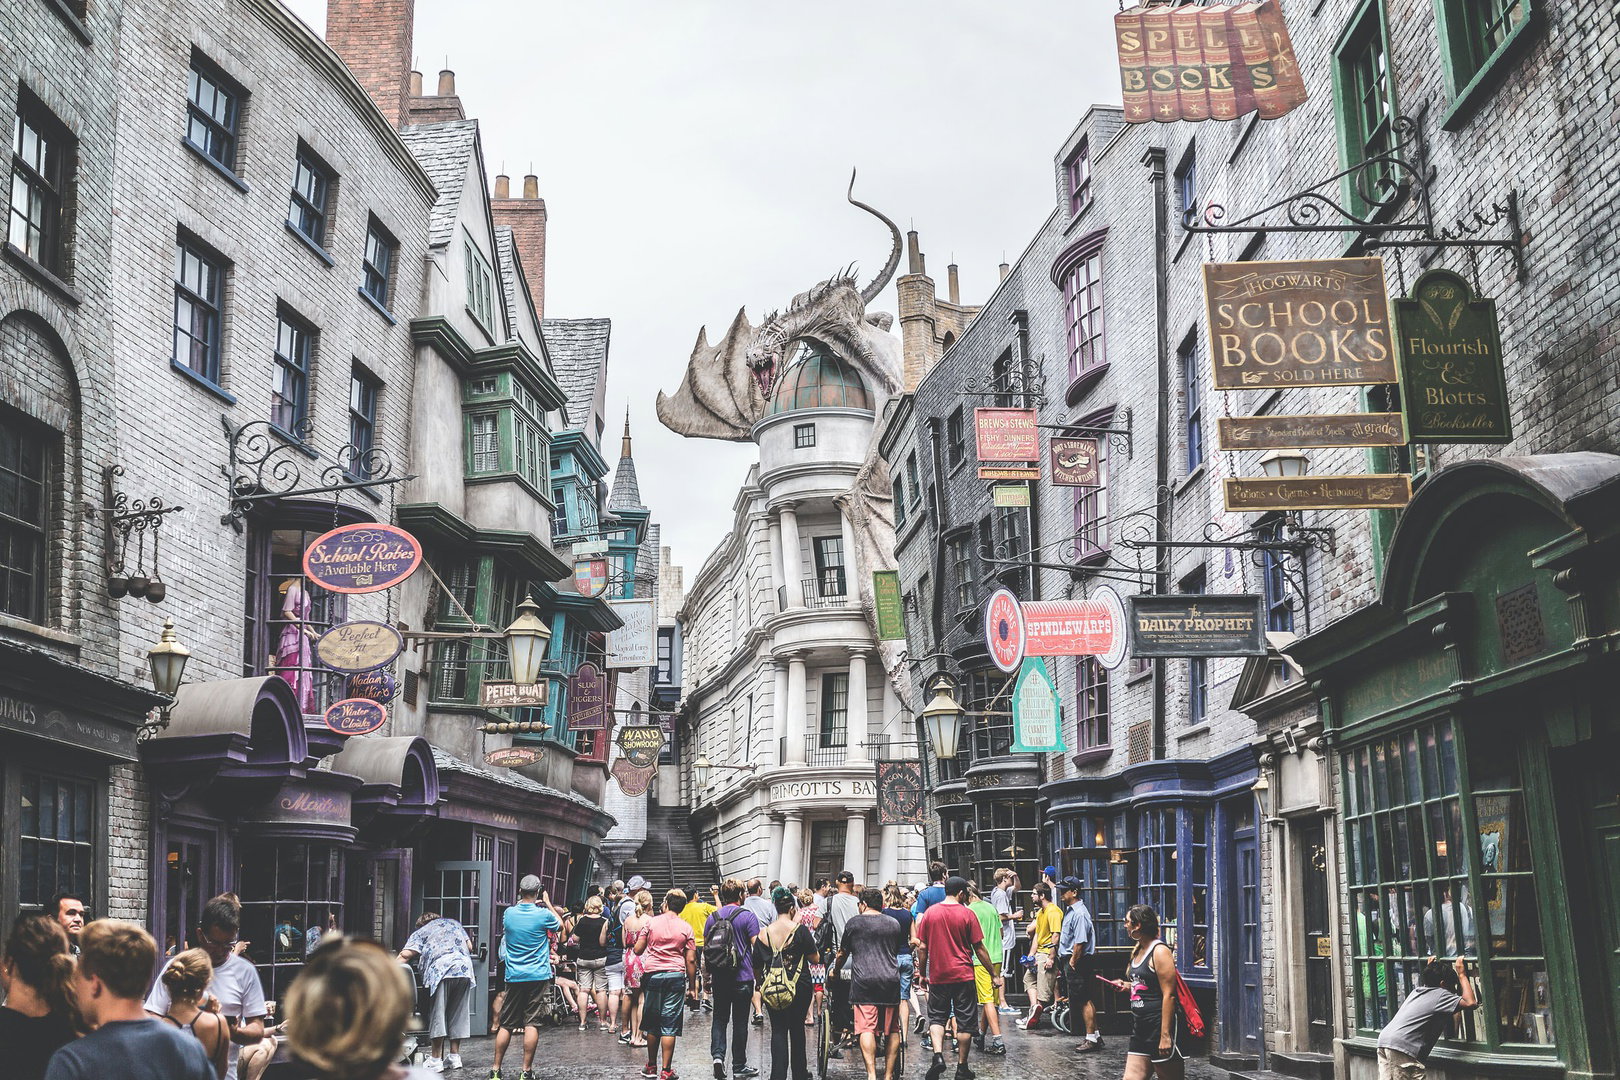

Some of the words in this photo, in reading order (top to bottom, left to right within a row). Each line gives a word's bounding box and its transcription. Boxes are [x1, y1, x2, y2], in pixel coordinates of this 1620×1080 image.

[1120, 28, 1260, 50] SPELL
[1123, 66, 1273, 90] BOOKS
[1249, 275, 1343, 293] HOGWARTS
[1218, 299, 1381, 330] SCHOOL
[1219, 328, 1388, 367] BOOKS
[1409, 337, 1489, 355] Flourish
[1273, 369, 1315, 382] SOLD
[1321, 367, 1365, 380] HERE
[1426, 387, 1487, 405] Blotts
[979, 418, 1005, 428] BREWS
[1009, 418, 1035, 428] STEWS
[1350, 422, 1364, 438] all
[1364, 422, 1399, 438] grades
[1233, 485, 1266, 502] Potions
[1277, 484, 1310, 501] Charms
[1320, 483, 1363, 500] Herbology
[310, 544, 367, 564] School
[365, 542, 416, 561] Robes
[324, 562, 372, 576] Available
[374, 561, 398, 573] Here
[1027, 619, 1112, 637] SPINDLEWARPS
[1139, 619, 1182, 632] DAILY
[1184, 618, 1254, 632] PROPHET
[338, 627, 381, 642] Perfect
[486, 684, 517, 702] PETER
[571, 695, 602, 703] JIGGERS
[342, 703, 369, 717] Winter
[341, 717, 371, 729] Cloaks
[623, 729, 659, 741] WAND
[623, 740, 659, 749] SHOWROOM
[772, 780, 842, 800] GRINGOTTS
[851, 780, 877, 795] BAN
[903, 774, 921, 790] ALLE
